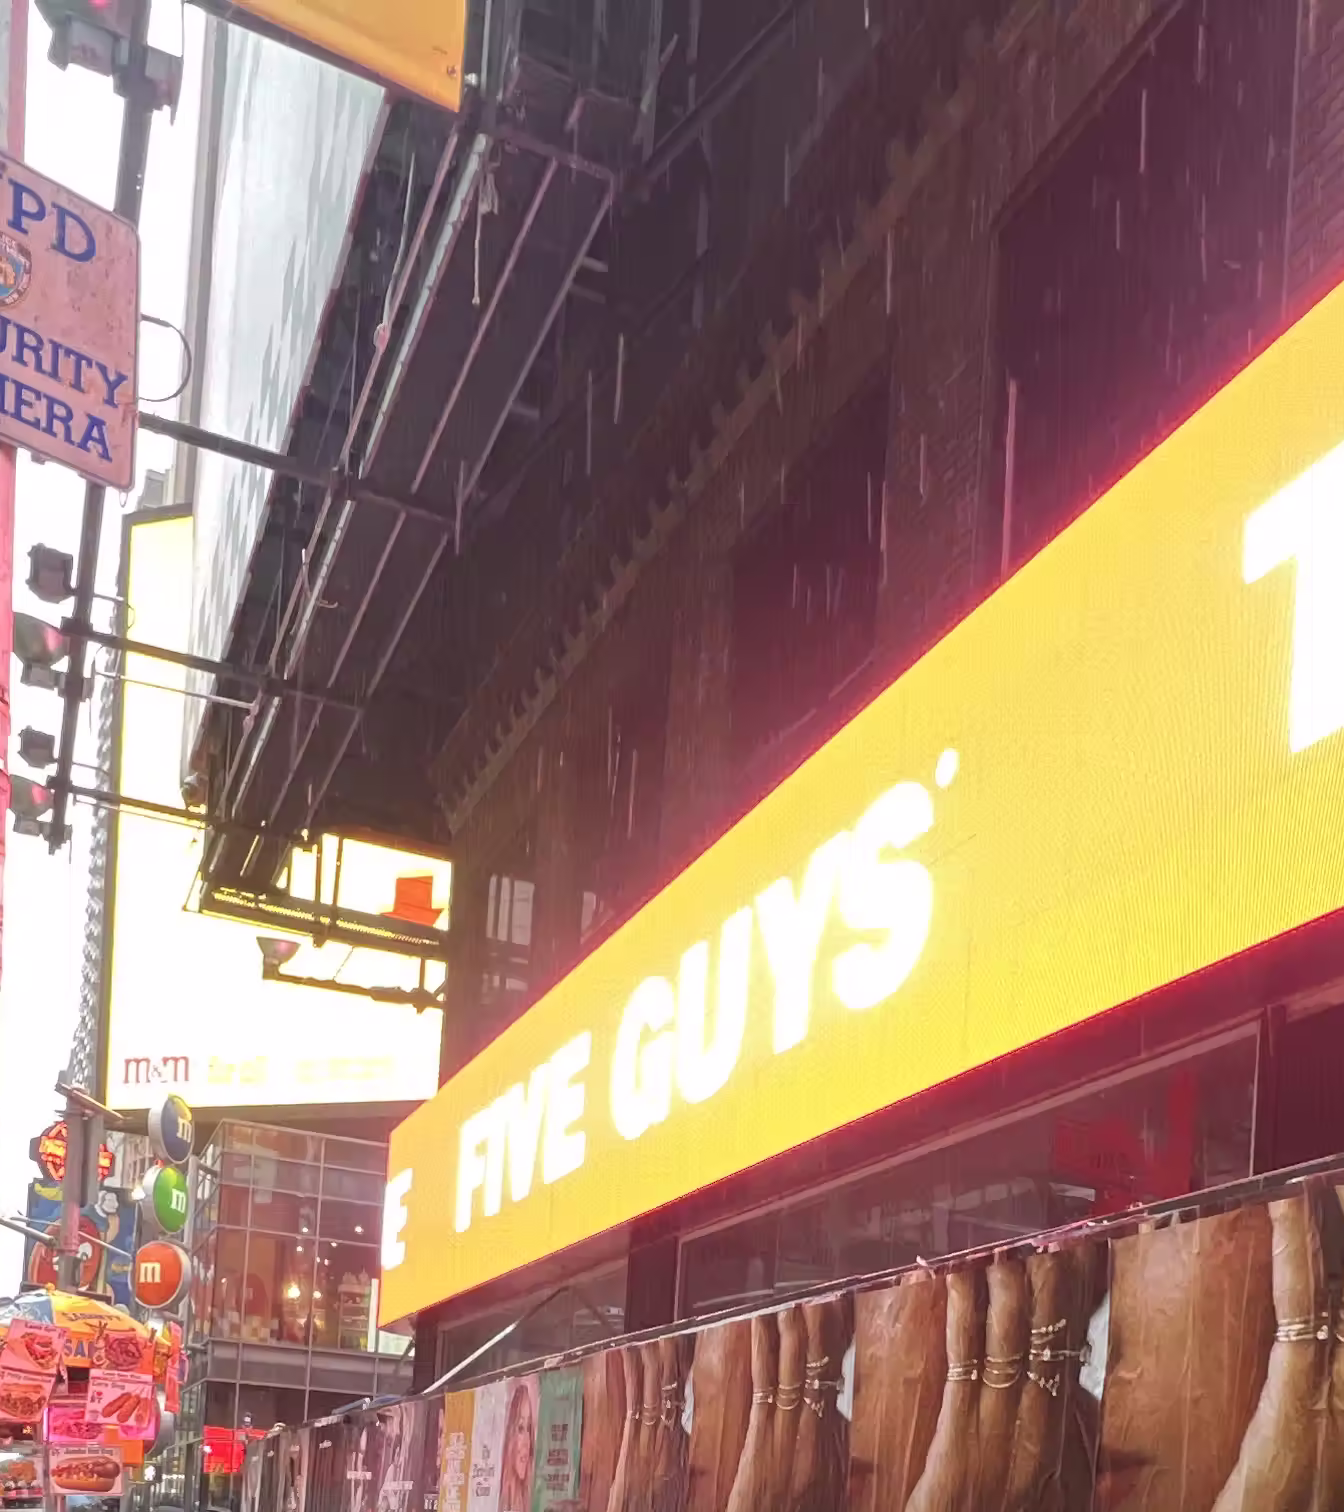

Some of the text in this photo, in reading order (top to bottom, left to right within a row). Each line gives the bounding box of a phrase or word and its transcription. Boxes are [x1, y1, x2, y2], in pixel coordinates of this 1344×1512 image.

[176, 1117, 193, 1143] m
[453, 1030, 592, 1234] FIVE
[170, 1188, 187, 1214] m
[139, 1262, 162, 1284] m
